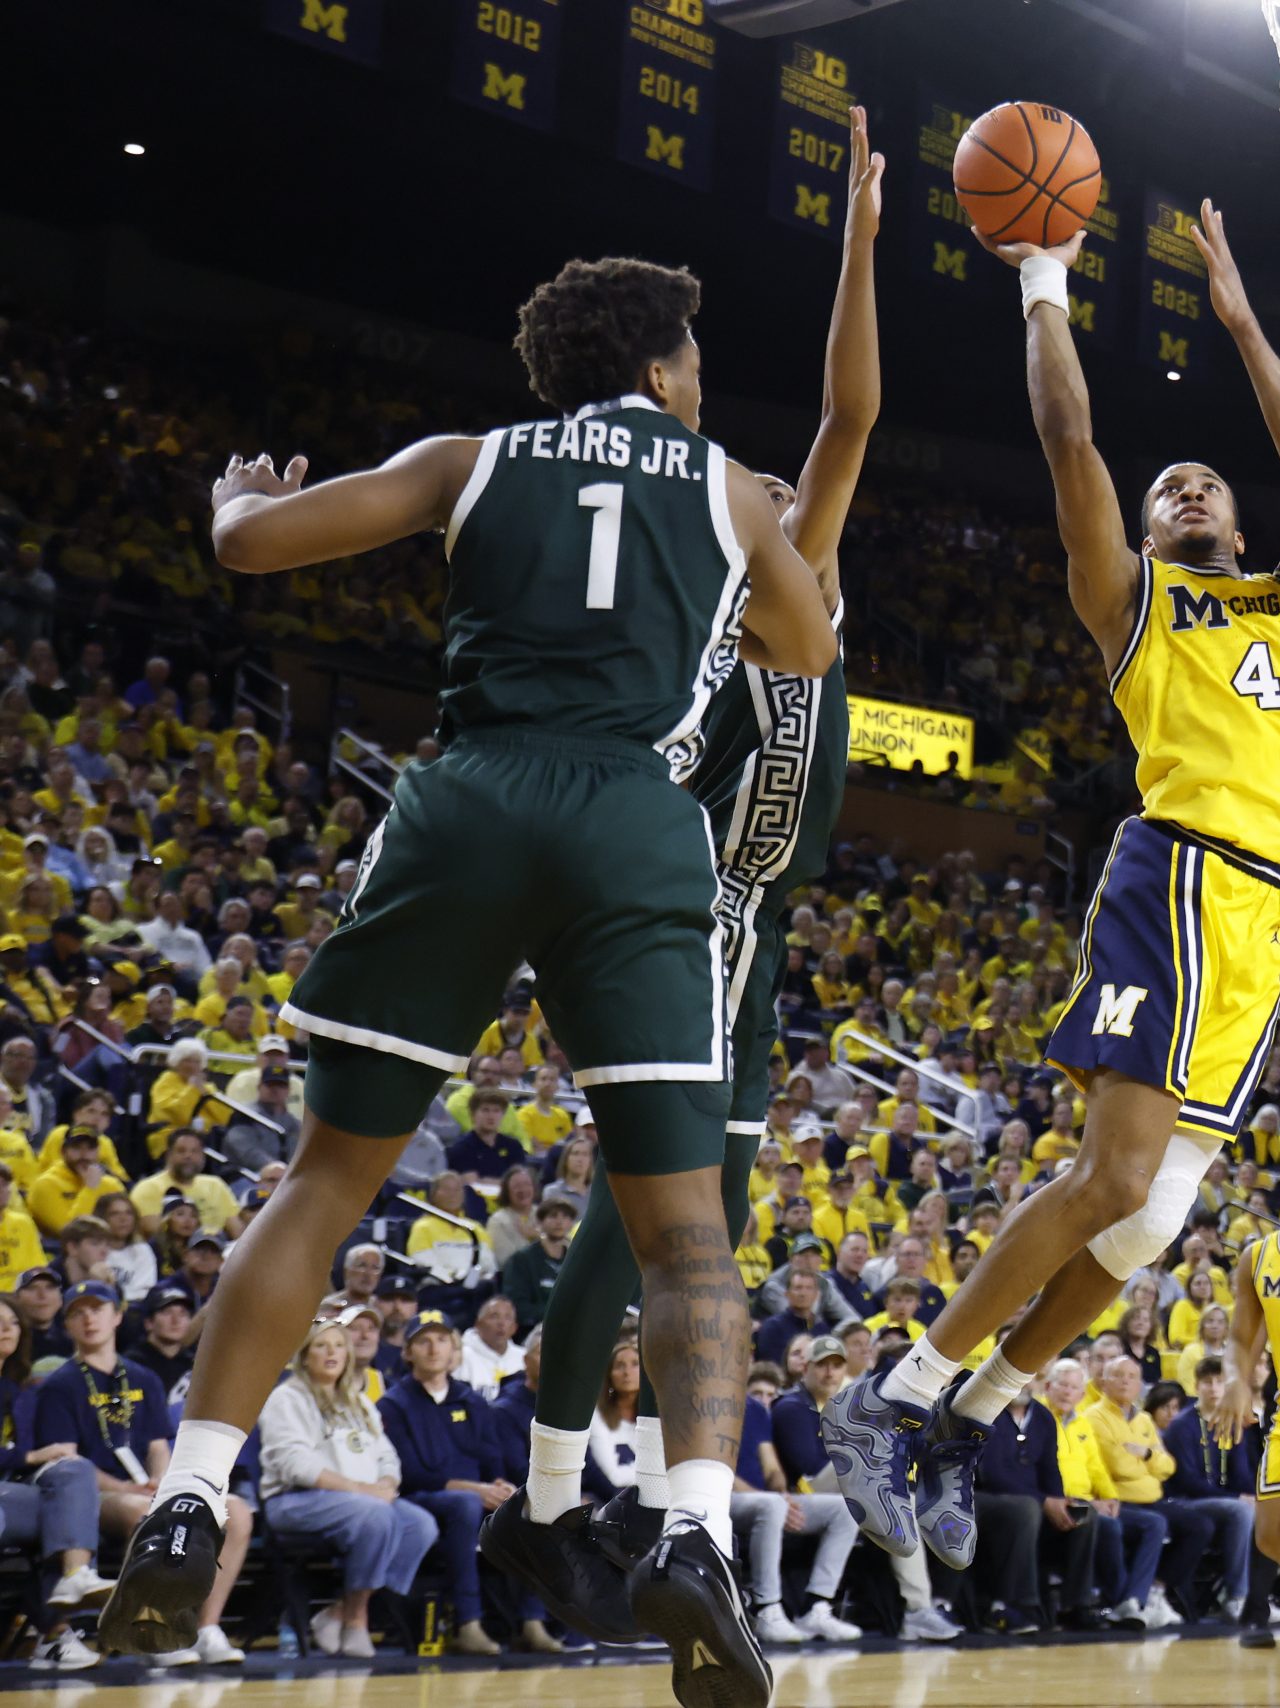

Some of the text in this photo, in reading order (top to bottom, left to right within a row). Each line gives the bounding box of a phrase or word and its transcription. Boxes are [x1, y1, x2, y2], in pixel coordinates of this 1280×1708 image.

[476, 1, 542, 53] 2012
[481, 62, 527, 110] M
[640, 66, 699, 115] 2014
[644, 124, 686, 170] M
[788, 127, 846, 173] 2017
[793, 183, 831, 227] M
[1152, 279, 1199, 320] 2025
[507, 420, 702, 480] FEARS JR.
[577, 483, 624, 609] 1
[850, 727, 914, 754] UNION
[863, 706, 967, 742] MICHIGAN
[1091, 983, 1149, 1038] M
[170, 1498, 205, 1514] GT
